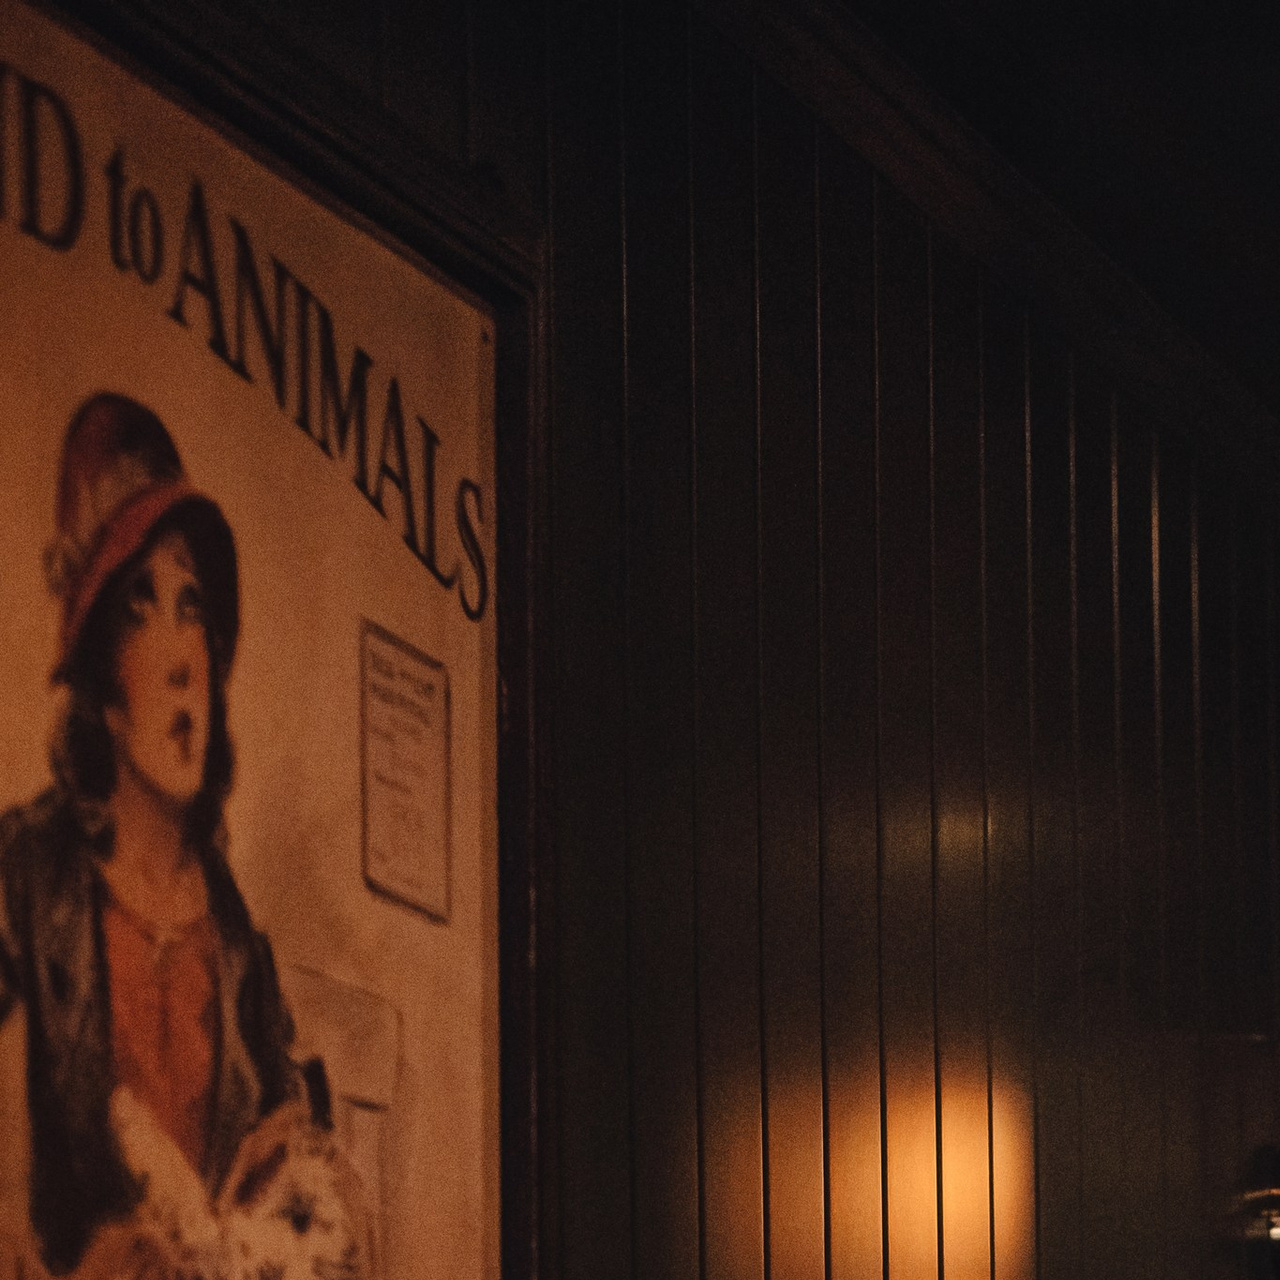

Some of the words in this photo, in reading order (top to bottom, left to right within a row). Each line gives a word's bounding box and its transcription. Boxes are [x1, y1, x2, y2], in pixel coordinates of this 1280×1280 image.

[0, 62, 84, 252] D
[106, 148, 165, 284] to
[167, 180, 489, 622] ANIMALS
